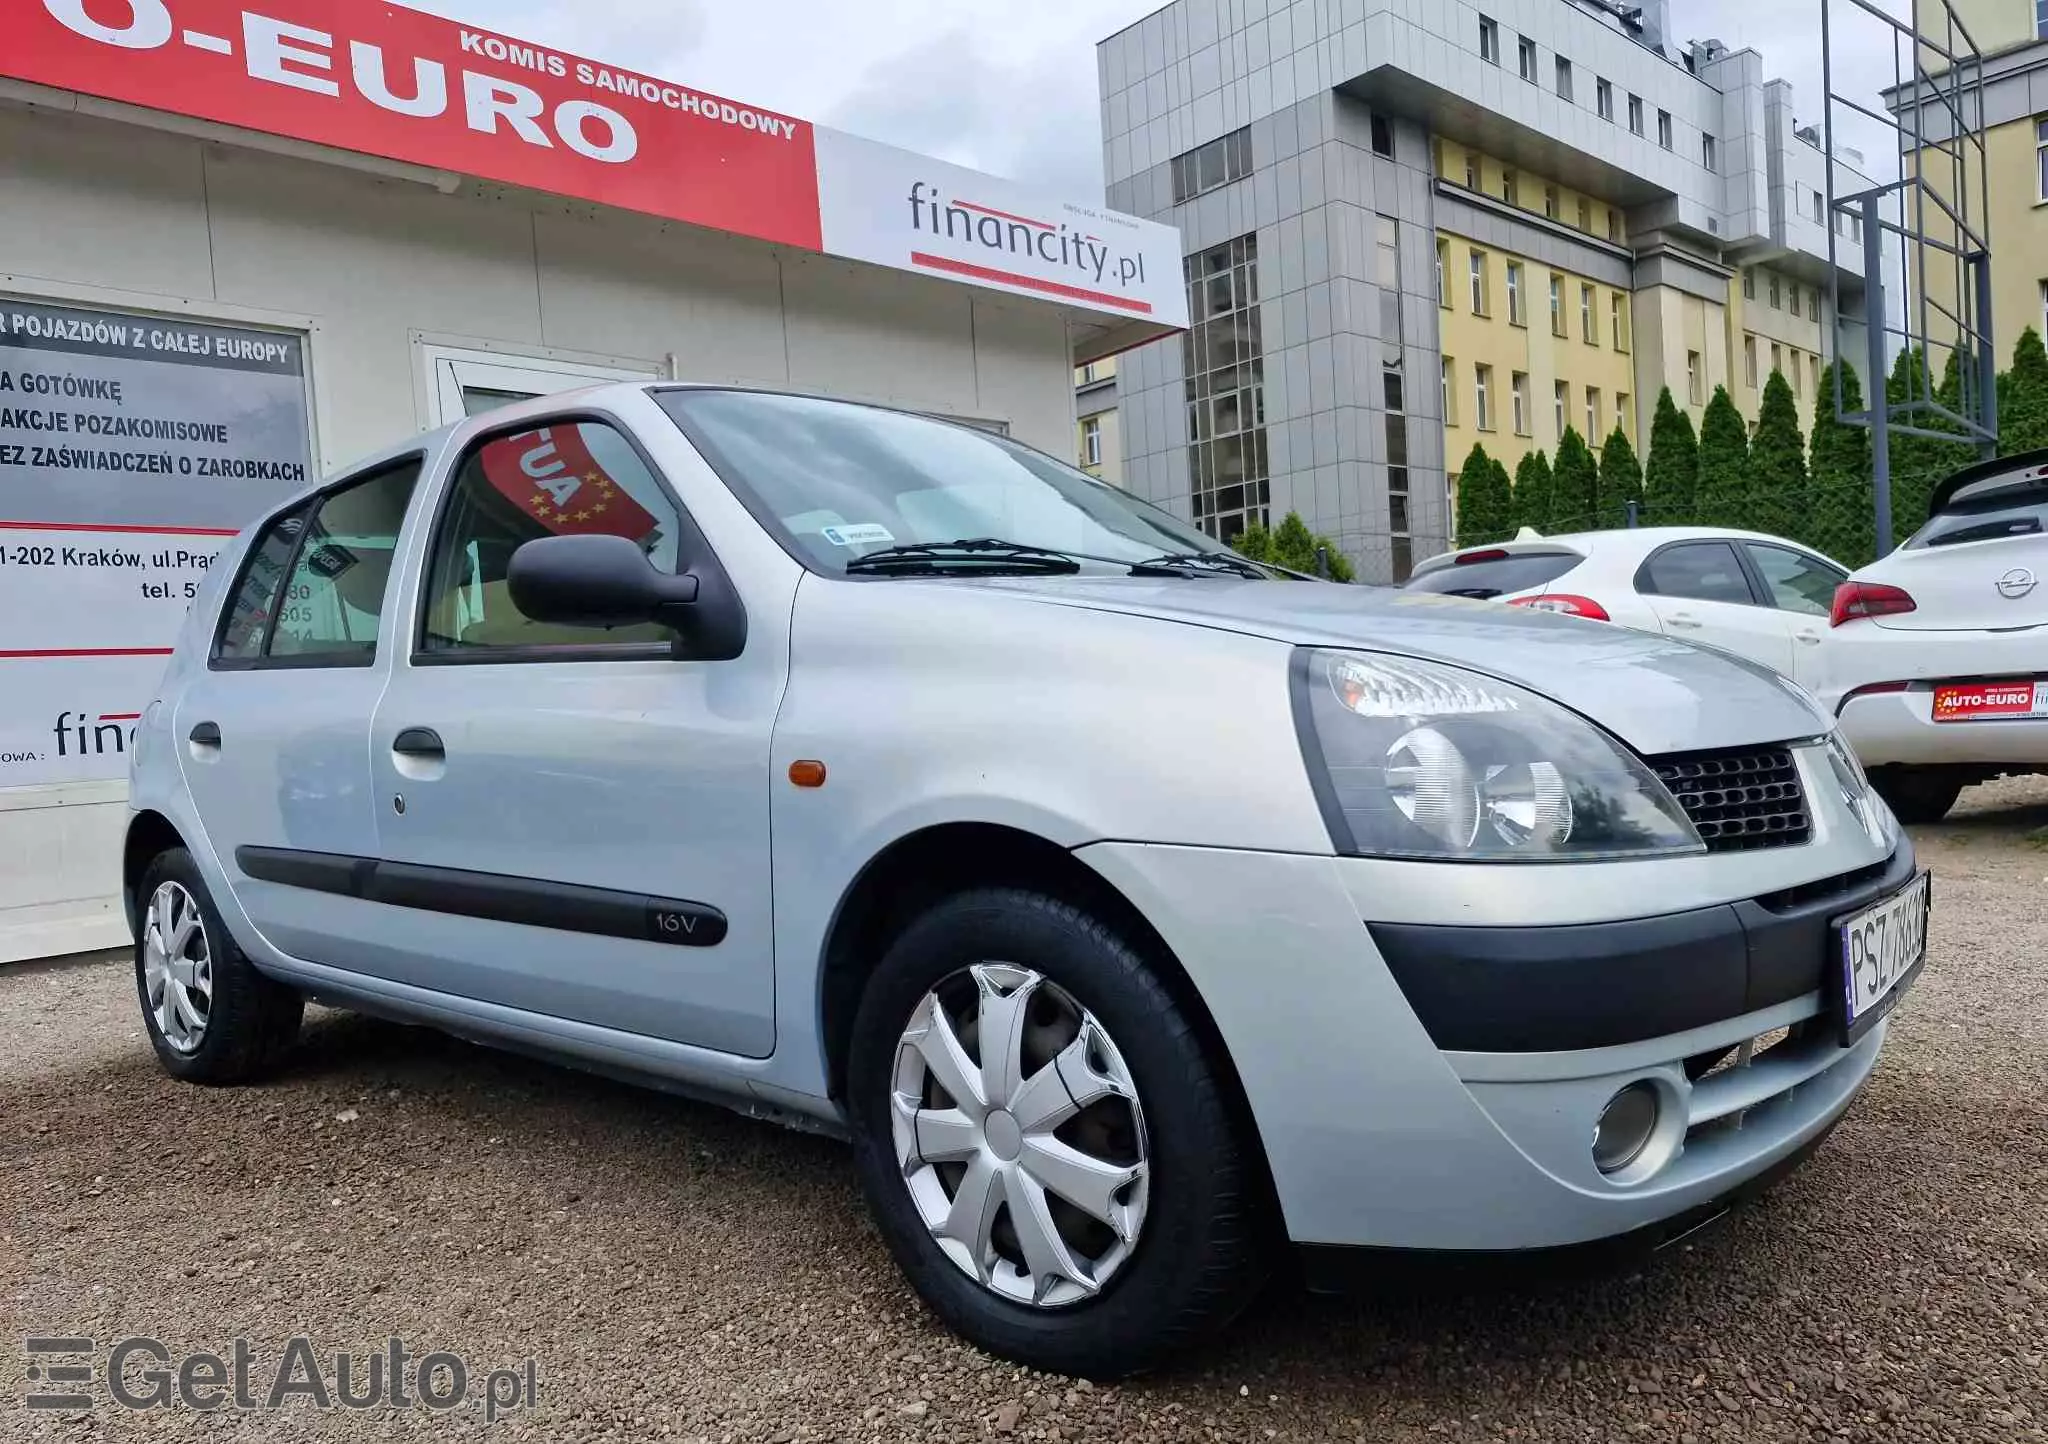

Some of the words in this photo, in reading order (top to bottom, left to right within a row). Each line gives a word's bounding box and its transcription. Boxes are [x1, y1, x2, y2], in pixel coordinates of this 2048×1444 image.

[460, 30, 566, 78] KOMIS
[576, 64, 797, 141] SAMOCHODOWY
[908, 181, 1144, 287] financity.pl
[12, 314, 126, 346] POJAZDÓW
[133, 328, 146, 348] Z
[151, 330, 210, 355] CAŁEJ
[216, 337, 288, 363] EUROPY
[20, 373, 122, 405] GOTÓWKĘ
[75, 414, 228, 443] POZAKOMISOWE
[32, 444, 173, 475] ZAŚWIADCZEŃ
[179, 453, 191, 475] O
[197, 457, 305, 481] ZAROBKACH
[63, 547, 146, 570] Kraków,
[142, 583, 176, 598] tel.
[1943, 693, 2029, 708] AUTO-EURO
[656, 913, 697, 934] 16V
[1851, 912, 1887, 1006] PSZ
